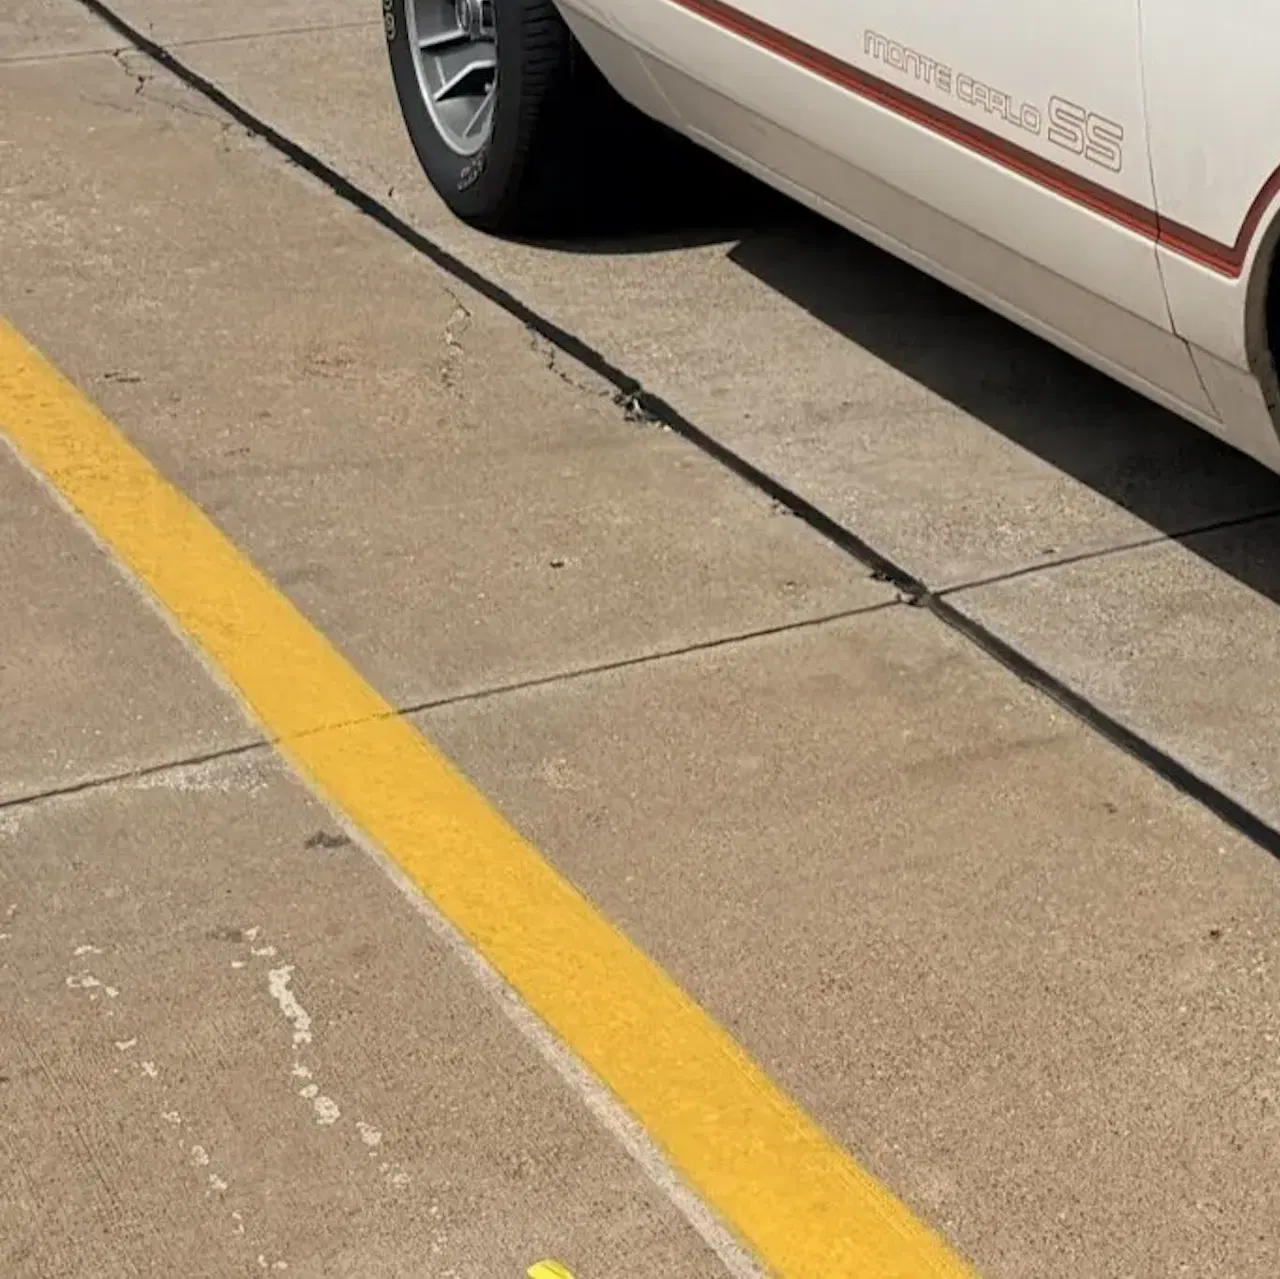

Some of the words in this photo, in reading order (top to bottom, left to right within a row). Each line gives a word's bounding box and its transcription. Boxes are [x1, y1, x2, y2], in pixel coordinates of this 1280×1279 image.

[864, 29, 952, 94] MONTE
[956, 72, 1041, 136] CARLO
[1047, 94, 1124, 173] SS
